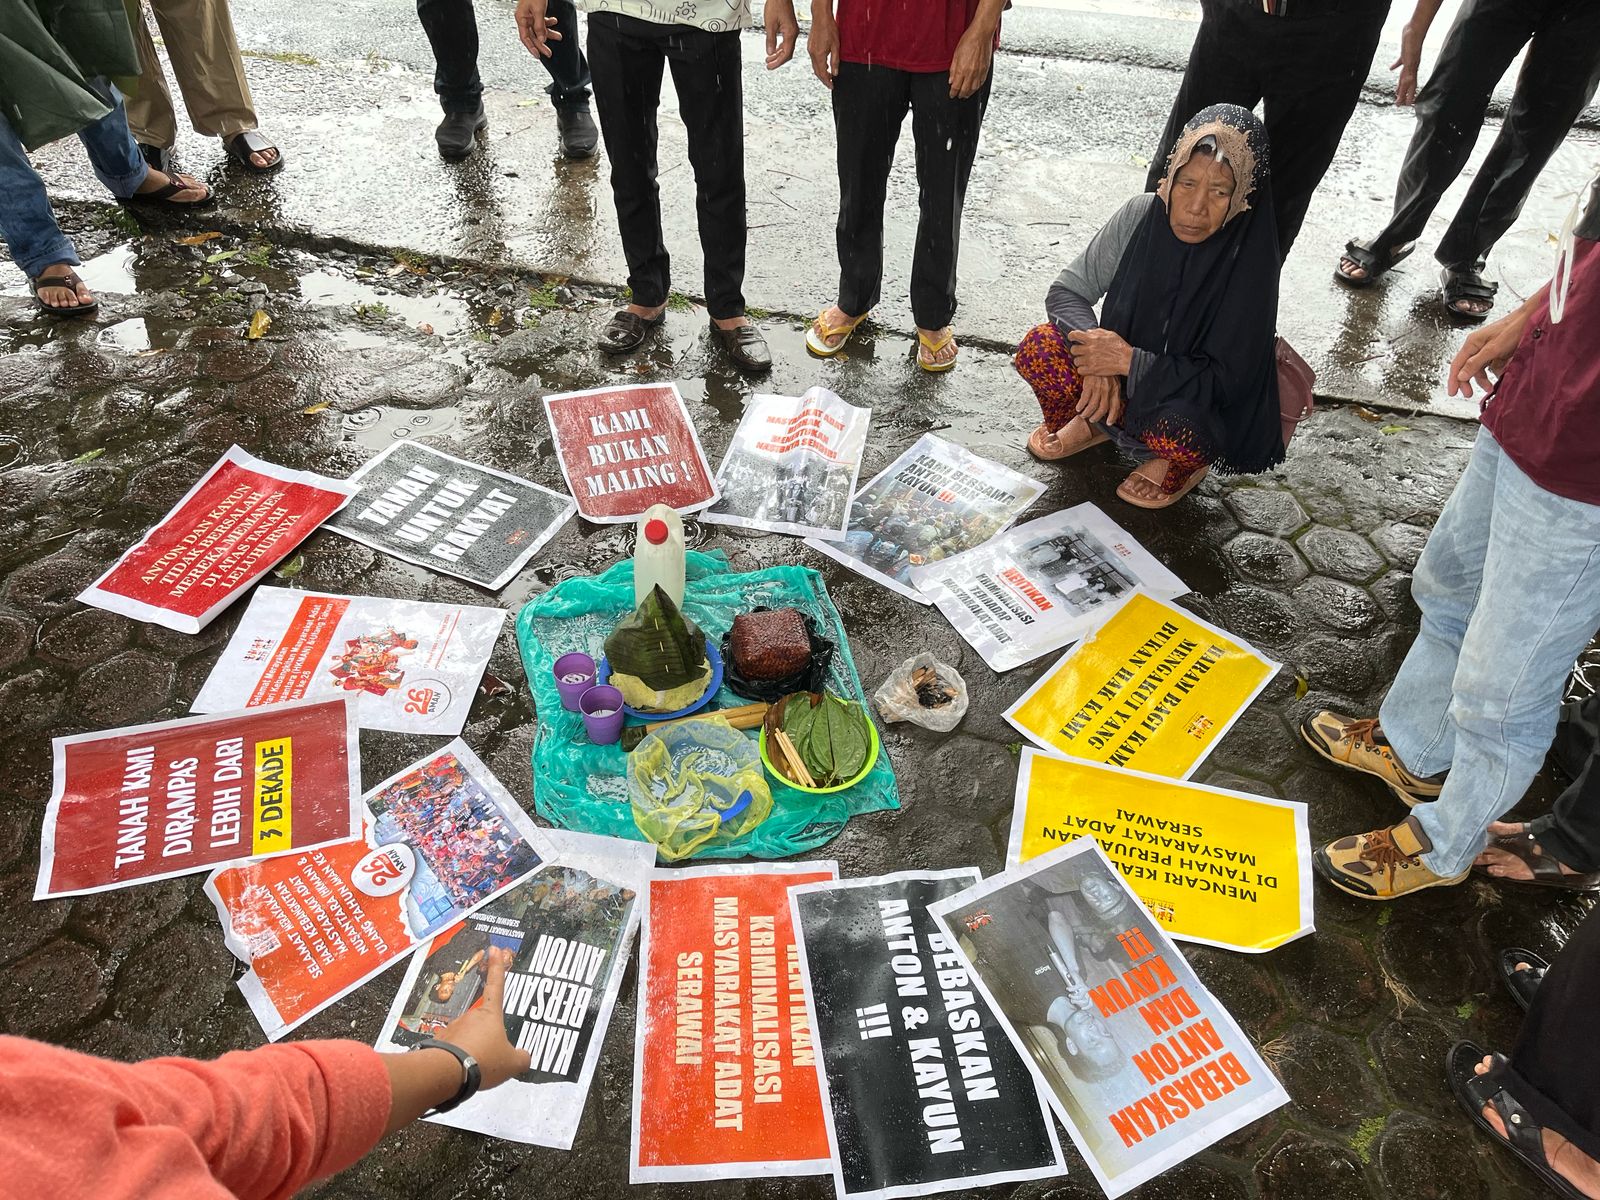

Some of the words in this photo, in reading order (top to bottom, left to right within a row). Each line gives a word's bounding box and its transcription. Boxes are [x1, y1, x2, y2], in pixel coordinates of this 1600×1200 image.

[589, 408, 652, 436] KAMI
[587, 435, 670, 467] BUKAN
[915, 454, 953, 476] KAMI
[356, 465, 441, 526] TANAH
[584, 463, 677, 497] MALING
[680, 460, 692, 481] !
[894, 472, 941, 496] KAYUN
[904, 463, 951, 488] ANTON
[394, 478, 480, 543] UNTUK
[429, 488, 519, 563] RAKYAT
[141, 545, 188, 585] ANTON
[183, 519, 214, 545] DAN
[208, 483, 252, 520] KAYUN
[160, 548, 201, 585] TIDAK
[200, 491, 263, 550] BERSALAH
[169, 543, 227, 598] MEREKA
[225, 490, 286, 548] MEMANEN
[201, 572, 223, 588] DI
[219, 544, 250, 572] ATAS
[247, 507, 289, 542] TANAH
[220, 514, 302, 588] LELUHURNYA
[969, 586, 1012, 622] TERHADAP
[975, 573, 1035, 625] KRIMINALISASI
[1128, 621, 1179, 669] BUKAN
[1097, 667, 1135, 702] HAK
[1123, 638, 1198, 711] MENGAKUI
[1174, 645, 1226, 695] HARAM
[404, 688, 434, 715] 26
[428, 691, 441, 713] AMAN
[1059, 699, 1103, 741] KAMI
[1140, 693, 1182, 733] BAGI
[1087, 711, 1132, 750] YANG
[121, 746, 155, 792] KAMI
[213, 737, 243, 782] DARI
[260, 745, 284, 822] DEKADE
[162, 757, 199, 857] DIRAMPAS
[210, 787, 242, 848] LEBIH
[1063, 815, 1116, 834] ADAT
[1116, 808, 1203, 837] SERAWAI
[114, 796, 149, 869] TANAH
[260, 829, 283, 841] 3
[1122, 827, 1256, 867] MASYARAKAT
[297, 857, 307, 866] &
[302, 866, 333, 898] (HKMAN)
[313, 854, 327, 866] KE
[322, 866, 344, 887] AMAN
[361, 853, 402, 886] 26
[386, 849, 407, 871] AMAN
[1180, 858, 1250, 883] TANAH
[1256, 874, 1278, 889] DI
[257, 885, 294, 932] MERAYAKAN
[274, 880, 317, 939] KEBANGKITAN
[289, 876, 310, 898] ADAT
[337, 886, 366, 923] TAHUN
[1165, 872, 1257, 902] MENCARI
[304, 896, 349, 953] MASYARAKAT
[326, 895, 369, 956] NUSANTARA
[360, 923, 388, 954] ULANG
[1116, 927, 1156, 961] !!!
[287, 932, 323, 979] SELAMAT
[312, 939, 335, 966] HARI
[528, 934, 607, 986] ANTON
[878, 899, 928, 997] ANTON
[714, 897, 741, 1056] MASYARAKAT
[1087, 955, 1178, 1018] KAYUN
[503, 971, 593, 1029] BERSAM
[675, 951, 703, 1065] SERAWAI
[750, 915, 782, 1104] KRIMINALISASI
[856, 1003, 892, 1040] !!!
[901, 1006, 929, 1030] &
[927, 932, 1000, 1101] BEBASKAN
[1138, 986, 1201, 1036] DAN
[1132, 1017, 1225, 1086] ANTON
[714, 1061, 743, 1132] ADAT
[908, 1037, 965, 1154] KAYUN
[1108, 1052, 1252, 1148] BEBASKAN
